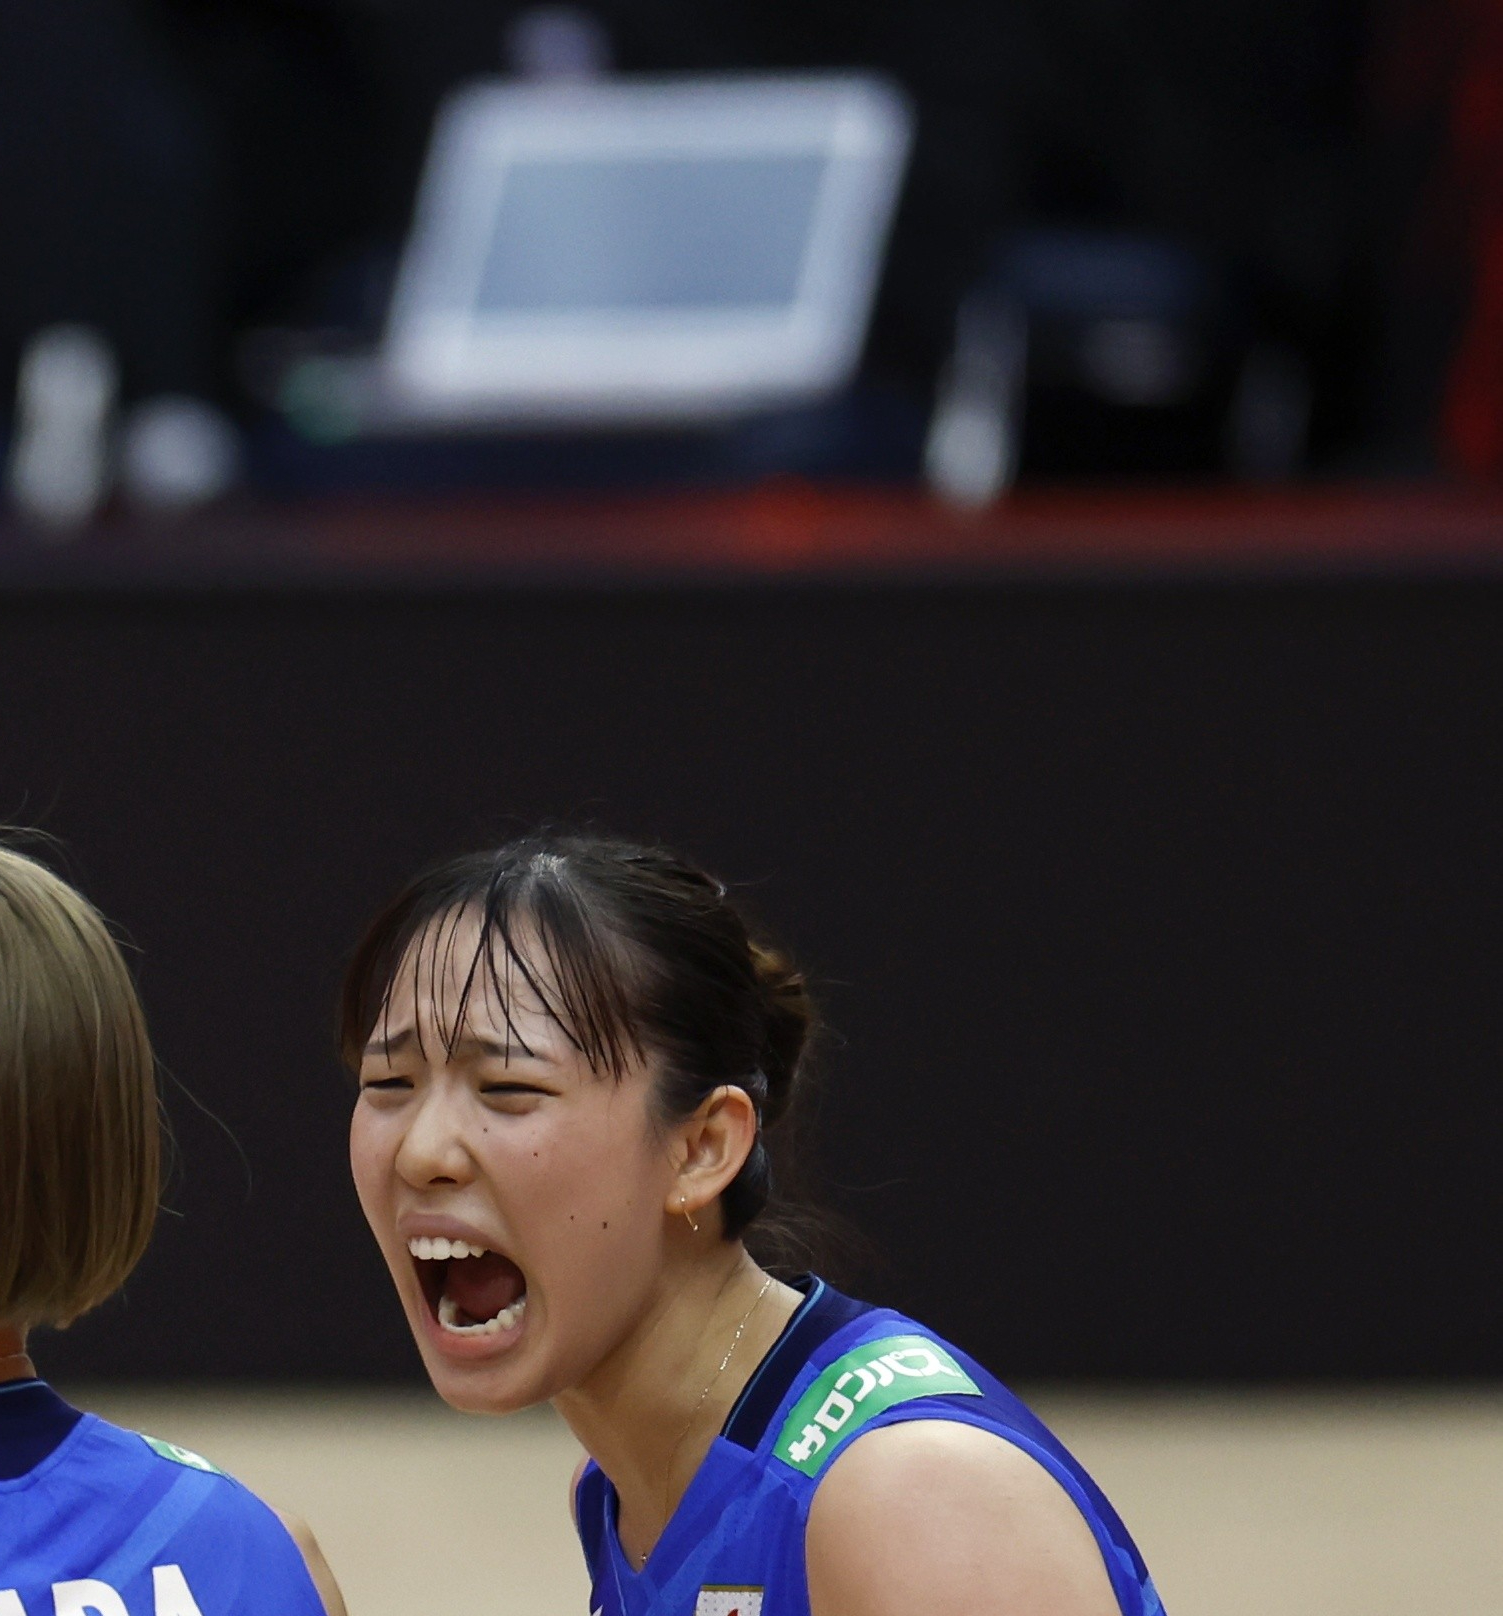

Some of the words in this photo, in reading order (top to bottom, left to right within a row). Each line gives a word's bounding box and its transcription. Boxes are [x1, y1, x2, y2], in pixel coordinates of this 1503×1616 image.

[788, 1348, 962, 1463] サロンパス
